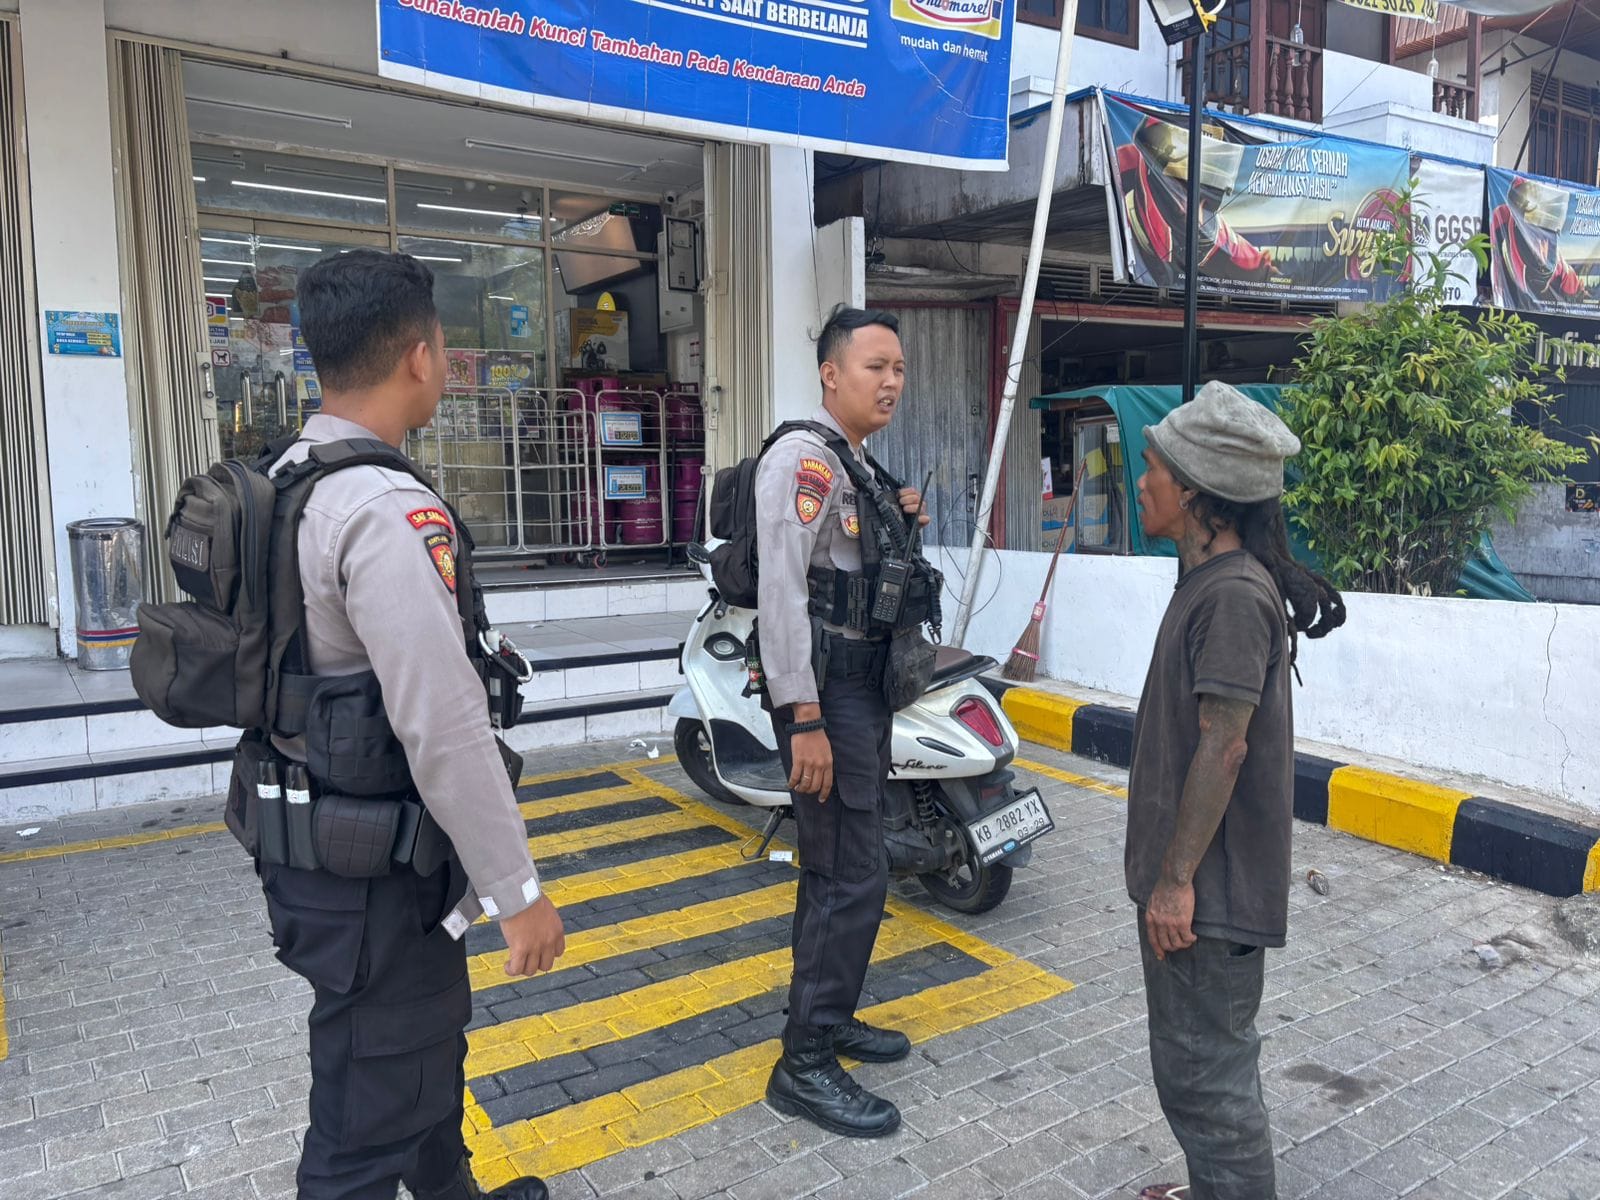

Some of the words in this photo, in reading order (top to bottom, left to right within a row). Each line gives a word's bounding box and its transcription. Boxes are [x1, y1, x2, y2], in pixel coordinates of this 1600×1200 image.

[719, 0, 764, 18] SAAT
[766, 1, 868, 38] BERBELANJA
[916, 0, 989, 15] ndomaret
[529, 15, 587, 47] Kunci
[590, 30, 684, 66] Tambahan
[686, 49, 729, 75] Pada
[733, 59, 821, 90] Kendaraan
[823, 73, 867, 97] Anda
[900, 34, 939, 51] mudah
[942, 40, 961, 55] dan
[962, 43, 989, 62] hemat
[1311, 149, 1348, 178] PERNAH
[1356, 216, 1370, 229] KITA
[1370, 217, 1391, 231] ADALAH
[1323, 211, 1397, 280] Sury
[974, 824, 992, 845] KB
[995, 807, 1026, 834] 2882
[1023, 799, 1041, 818] YX
